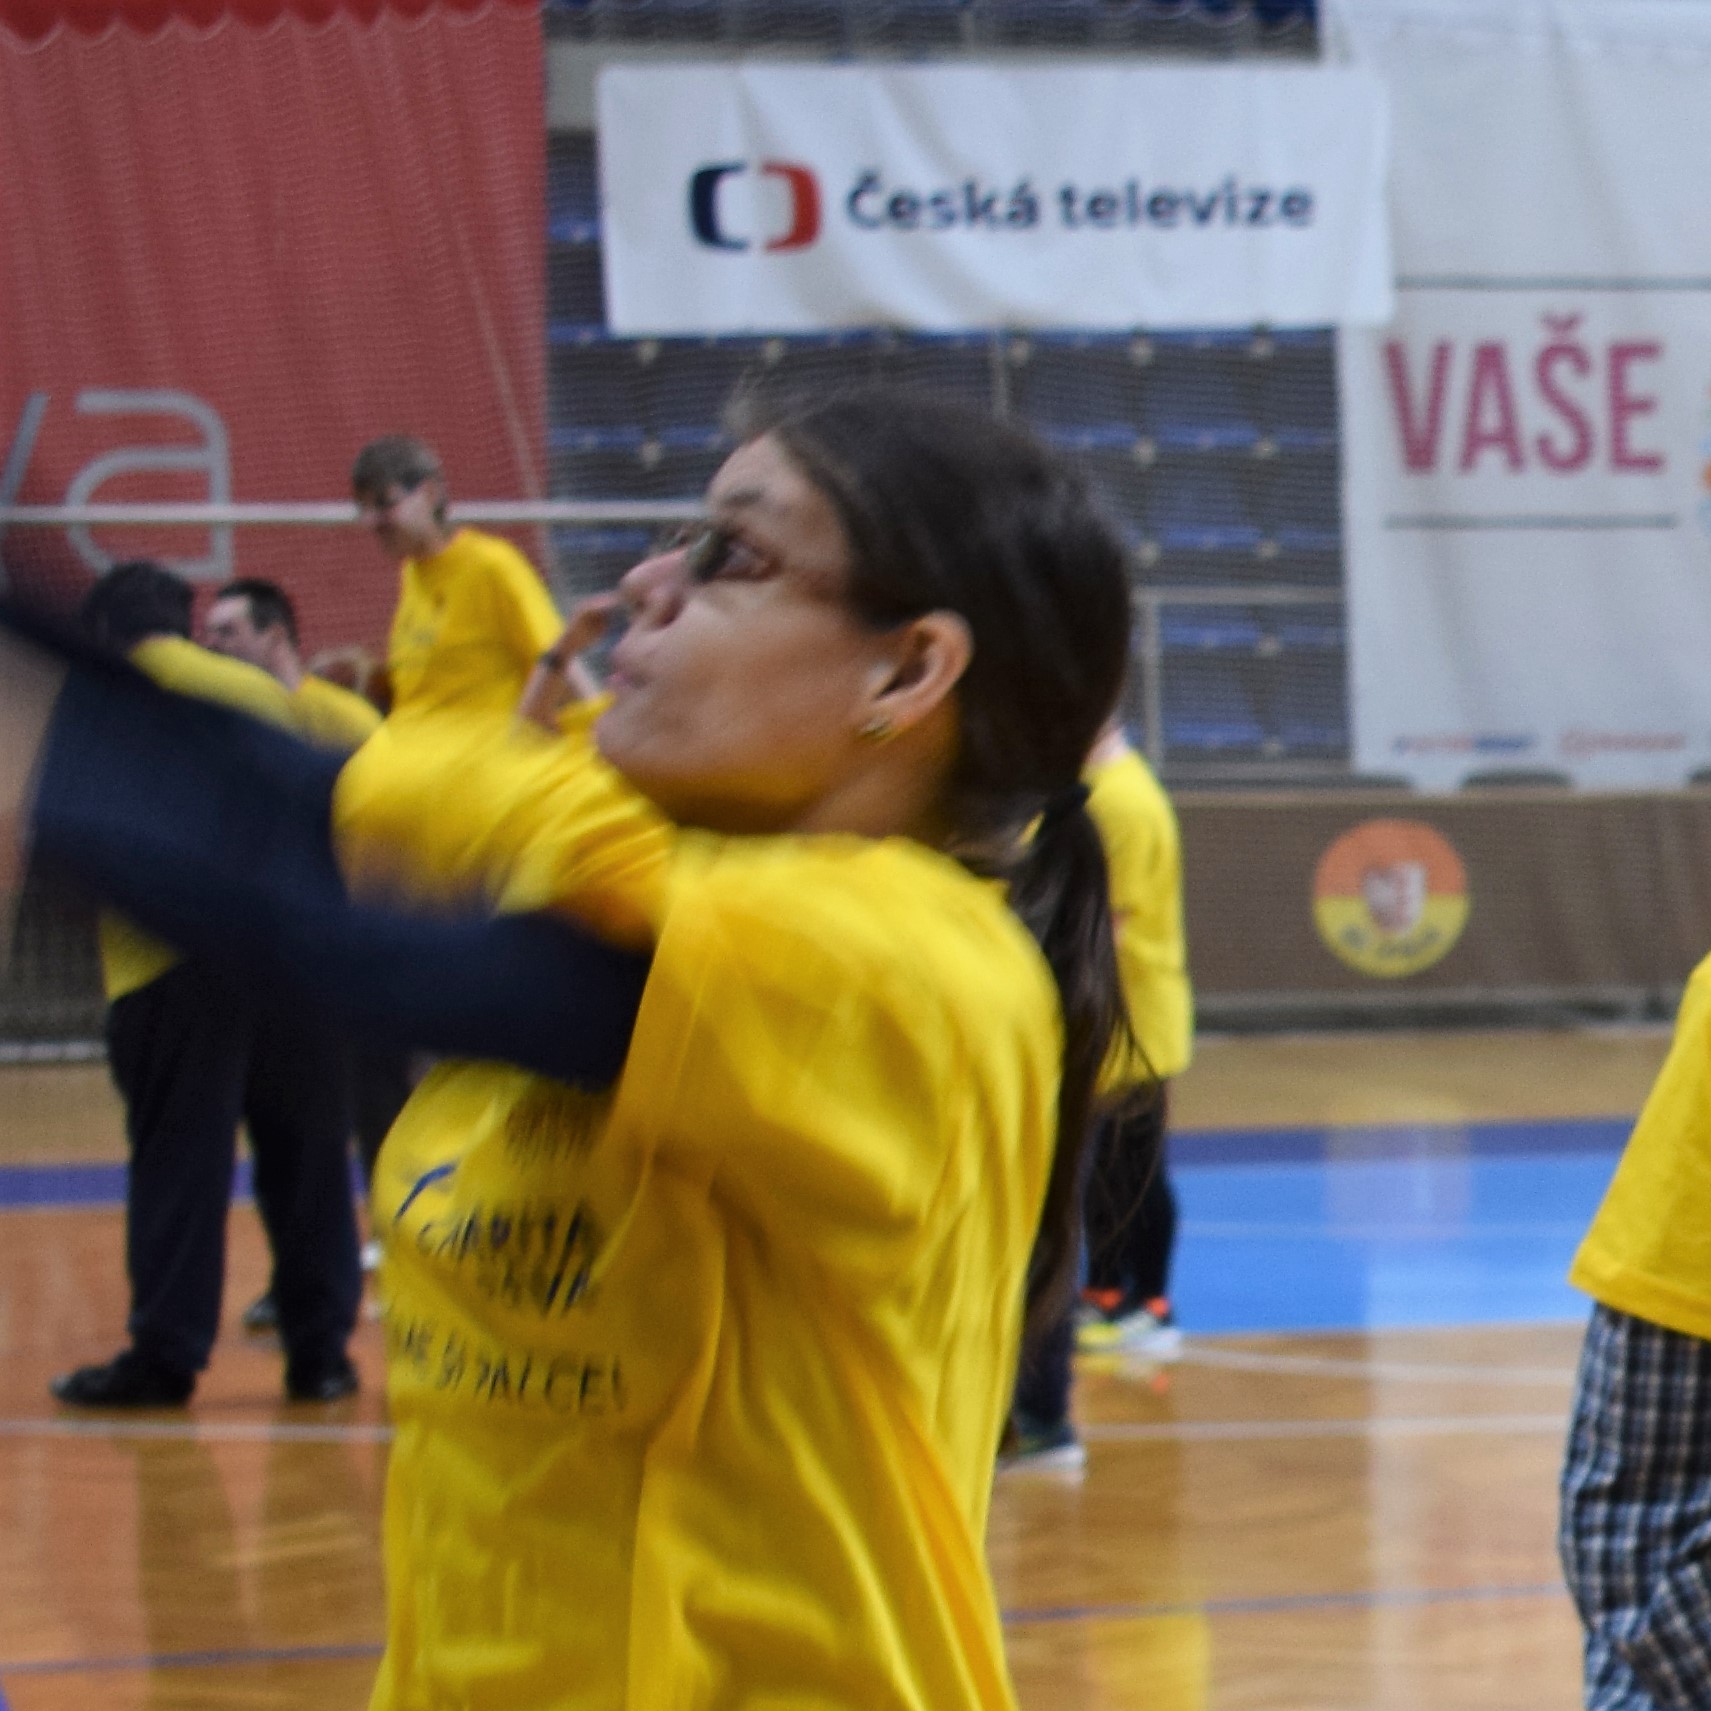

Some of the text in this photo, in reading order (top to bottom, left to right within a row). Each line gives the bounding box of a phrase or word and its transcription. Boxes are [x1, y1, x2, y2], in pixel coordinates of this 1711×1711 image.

[846, 168, 1317, 230] Česká televize
[1382, 312, 1666, 475] VAŠE
